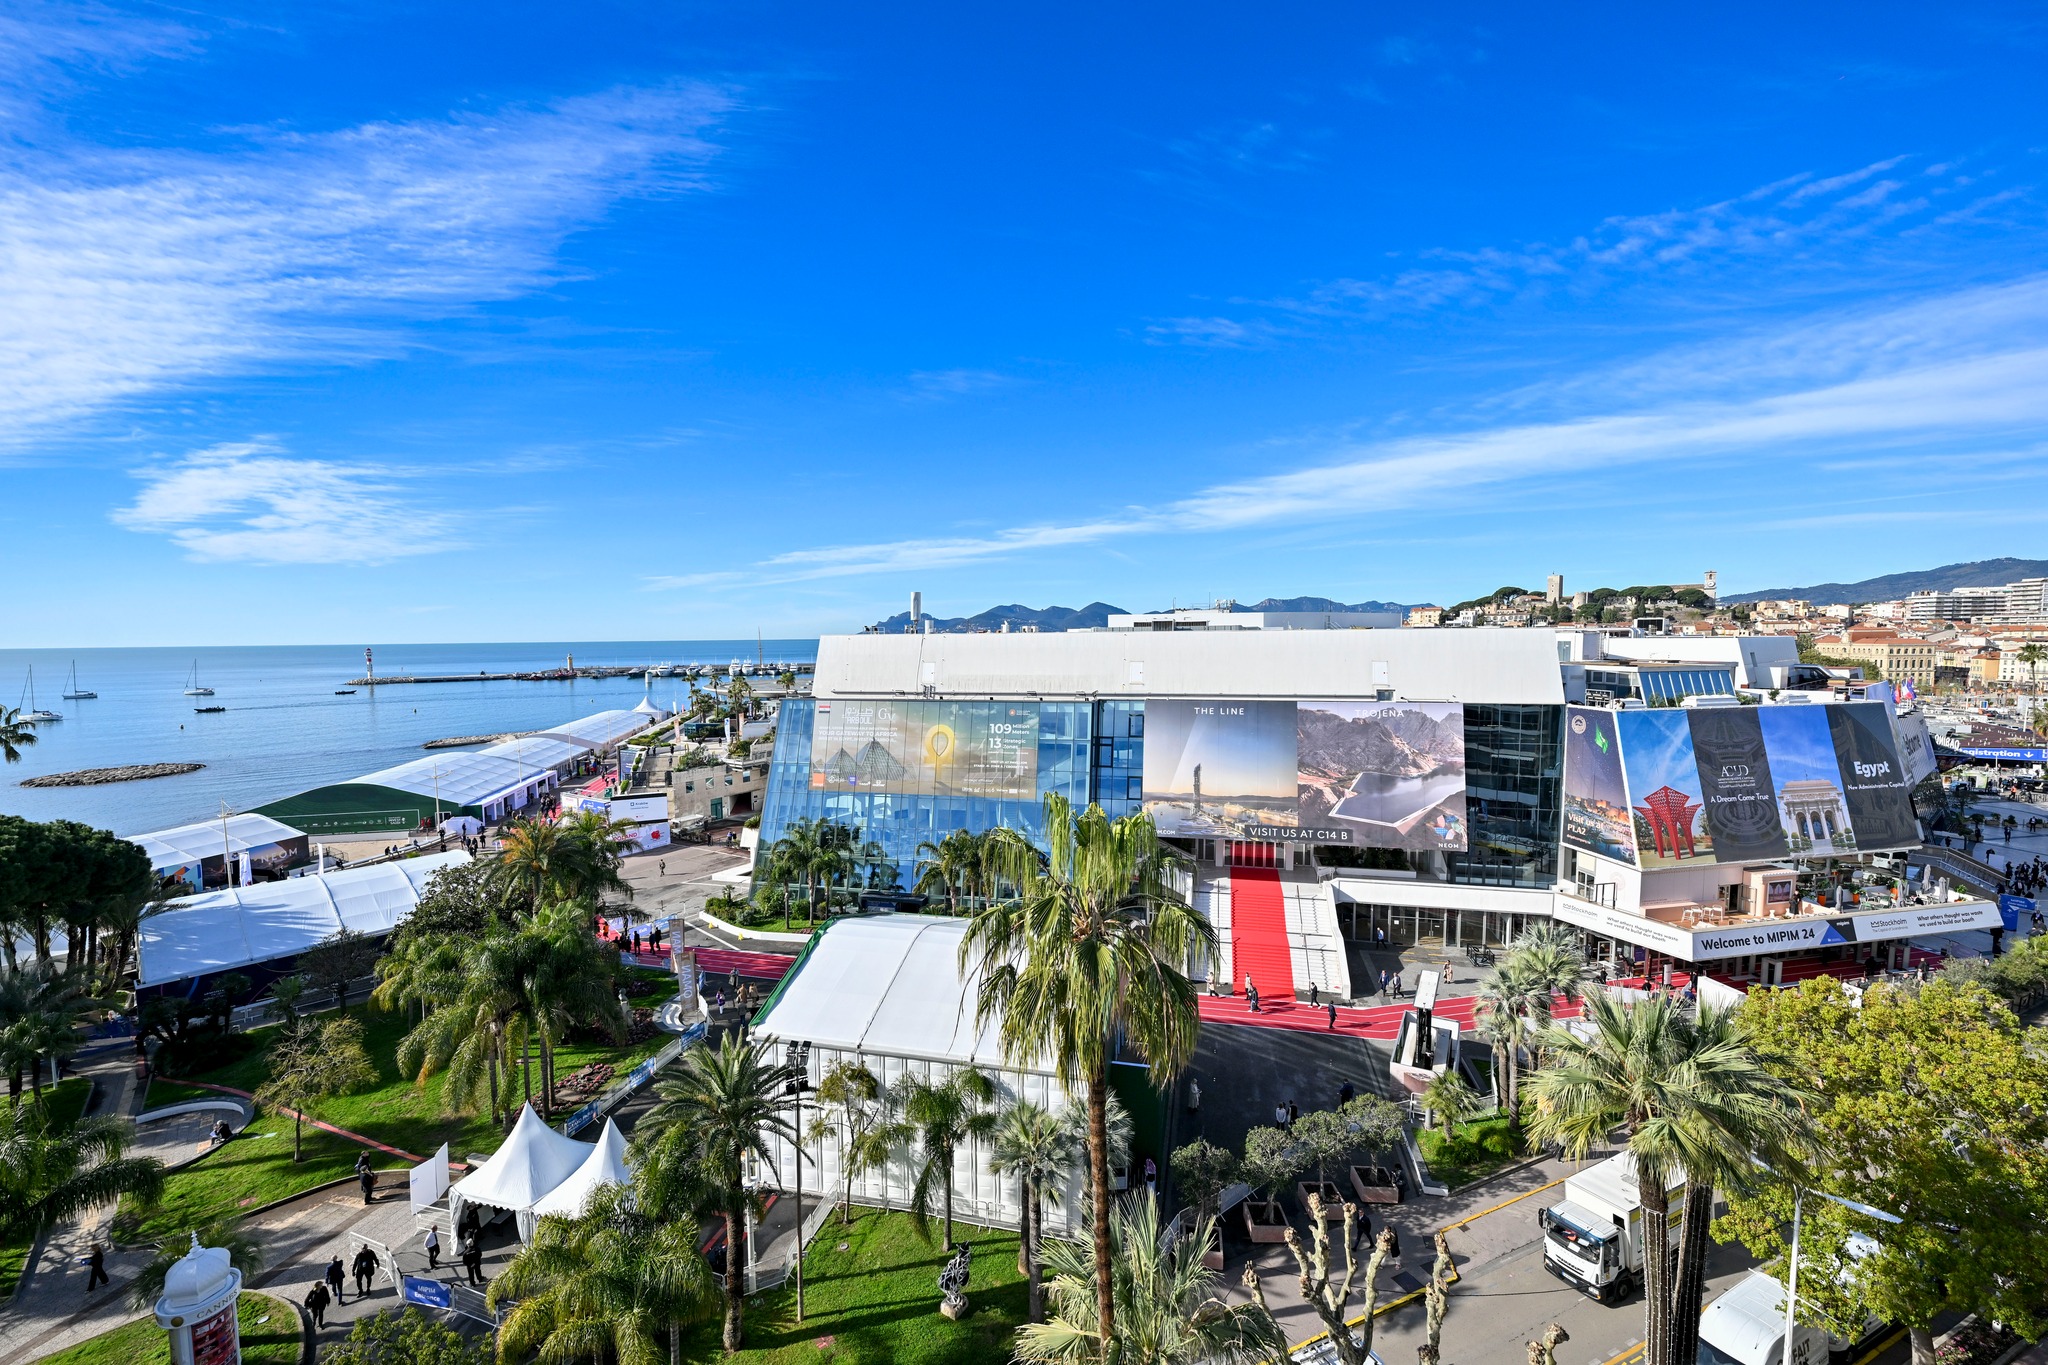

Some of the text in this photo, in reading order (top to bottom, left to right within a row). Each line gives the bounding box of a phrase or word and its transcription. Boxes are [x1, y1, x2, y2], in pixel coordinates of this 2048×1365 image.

[1194, 706, 1245, 716] THE LINE
[1354, 708, 1405, 719] TROJENA
[989, 723, 1012, 735] 109
[988, 737, 1002, 749] 13
[1853, 761, 1891, 778] Egypt
[1847, 779, 1905, 791] New Administrative Capital
[1710, 791, 1769, 803] A Dream Come True
[1568, 812, 1584, 825] Visit
[1585, 819, 1595, 828] us
[1249, 826, 1349, 842] VISIT US AT C14 B
[1437, 842, 1460, 850] NEOM
[260, 846, 299, 863] NEOM
[1571, 903, 1599, 918] Stockholm
[1916, 914, 1929, 922] What
[1930, 913, 1943, 921] others
[1943, 911, 1961, 920] thought
[1970, 909, 1984, 917] waste
[1606, 916, 1620, 924] What
[1619, 920, 1634, 929] others
[1634, 924, 1653, 936] thought
[1880, 917, 1908, 928] Stockholm
[1942, 918, 1954, 926] build
[1962, 915, 1975, 924] booth
[1701, 927, 1816, 951] Welcome to MIPIM 24
[414, 1291, 441, 1302] Entrance
[196, 1288, 238, 1319] CANNES
[1791, 1337, 1810, 1363] FAIT
